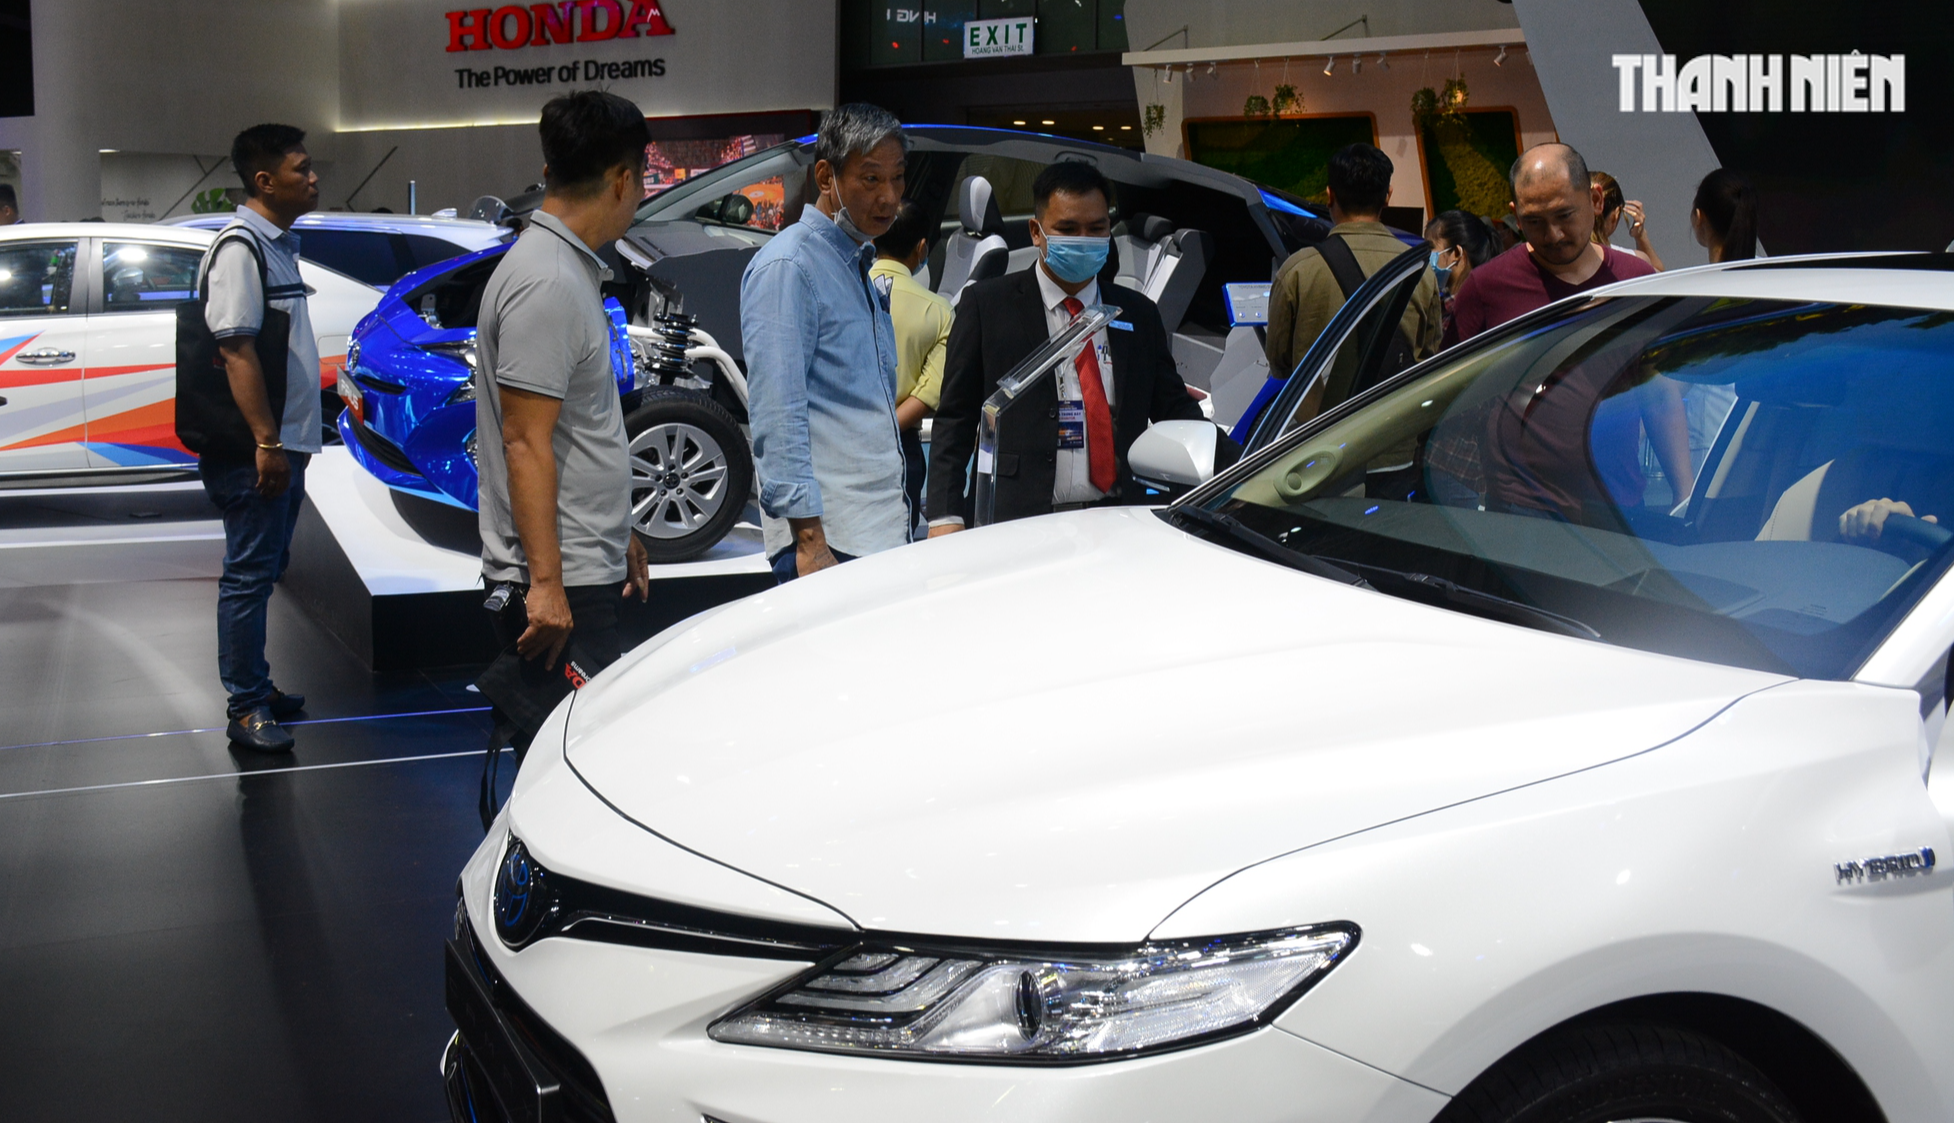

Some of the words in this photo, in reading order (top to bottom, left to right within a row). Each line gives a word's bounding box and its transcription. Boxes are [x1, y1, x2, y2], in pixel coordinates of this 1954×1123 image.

[446, 0, 675, 52] HONDA
[970, 23, 1027, 46] EXIT
[455, 68, 491, 88] The
[494, 66, 555, 86] Power
[558, 60, 580, 83] of
[584, 58, 666, 81] Dreams
[1833, 853, 1920, 882] HYBRID
